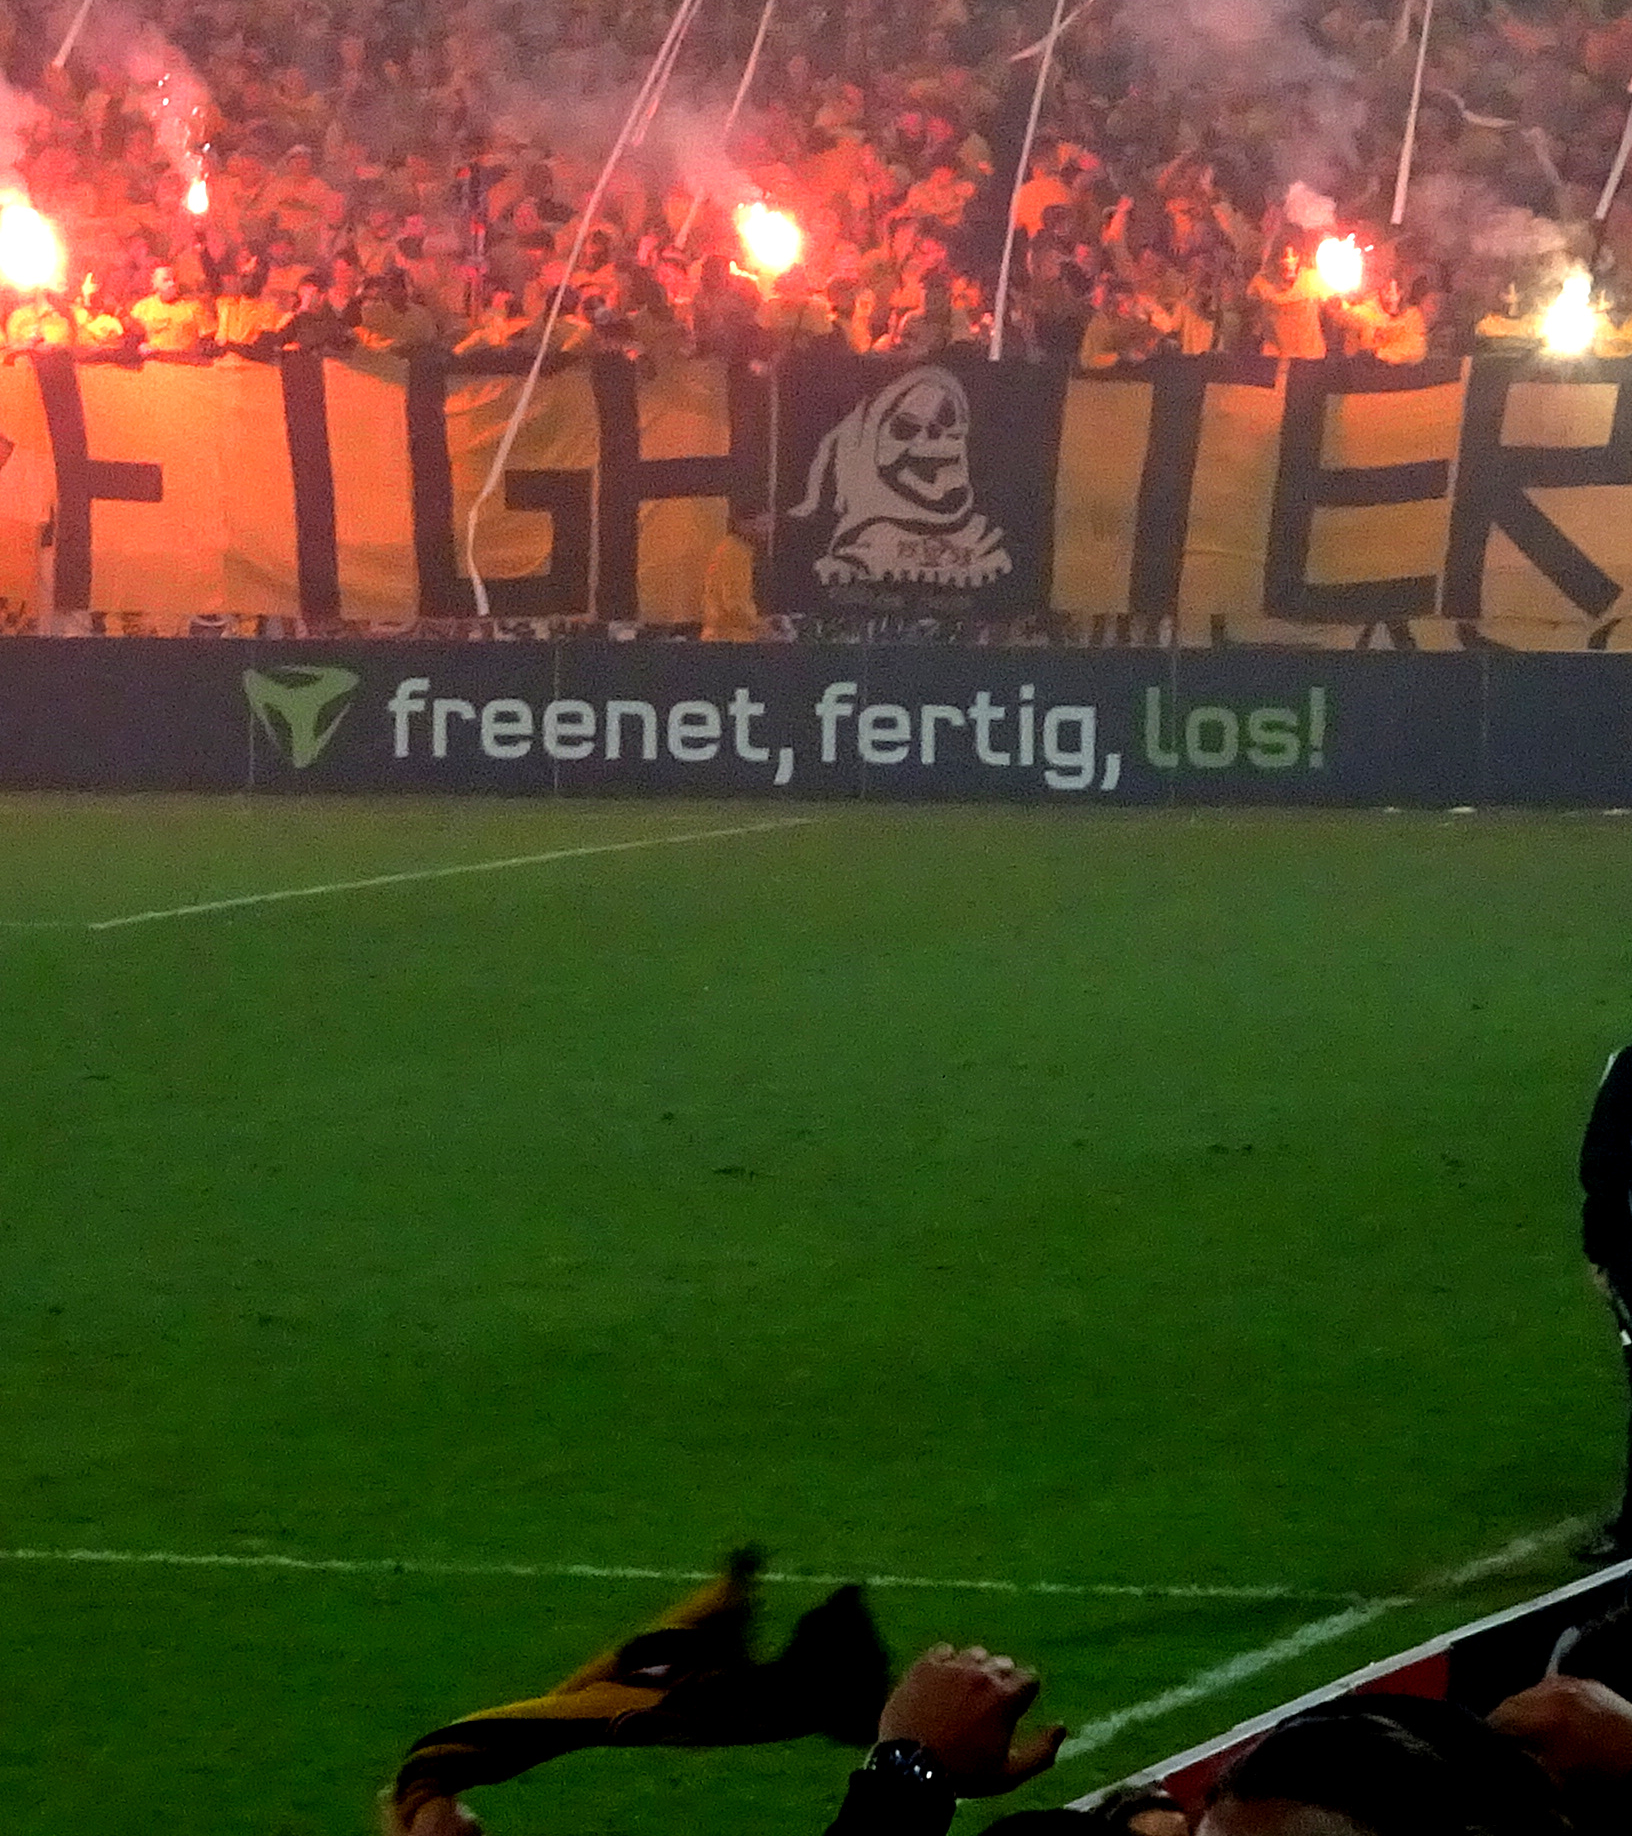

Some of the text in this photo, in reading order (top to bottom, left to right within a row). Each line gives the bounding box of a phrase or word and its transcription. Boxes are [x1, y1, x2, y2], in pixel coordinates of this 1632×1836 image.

[388, 677, 1327, 792] freenet, fertig, los!
